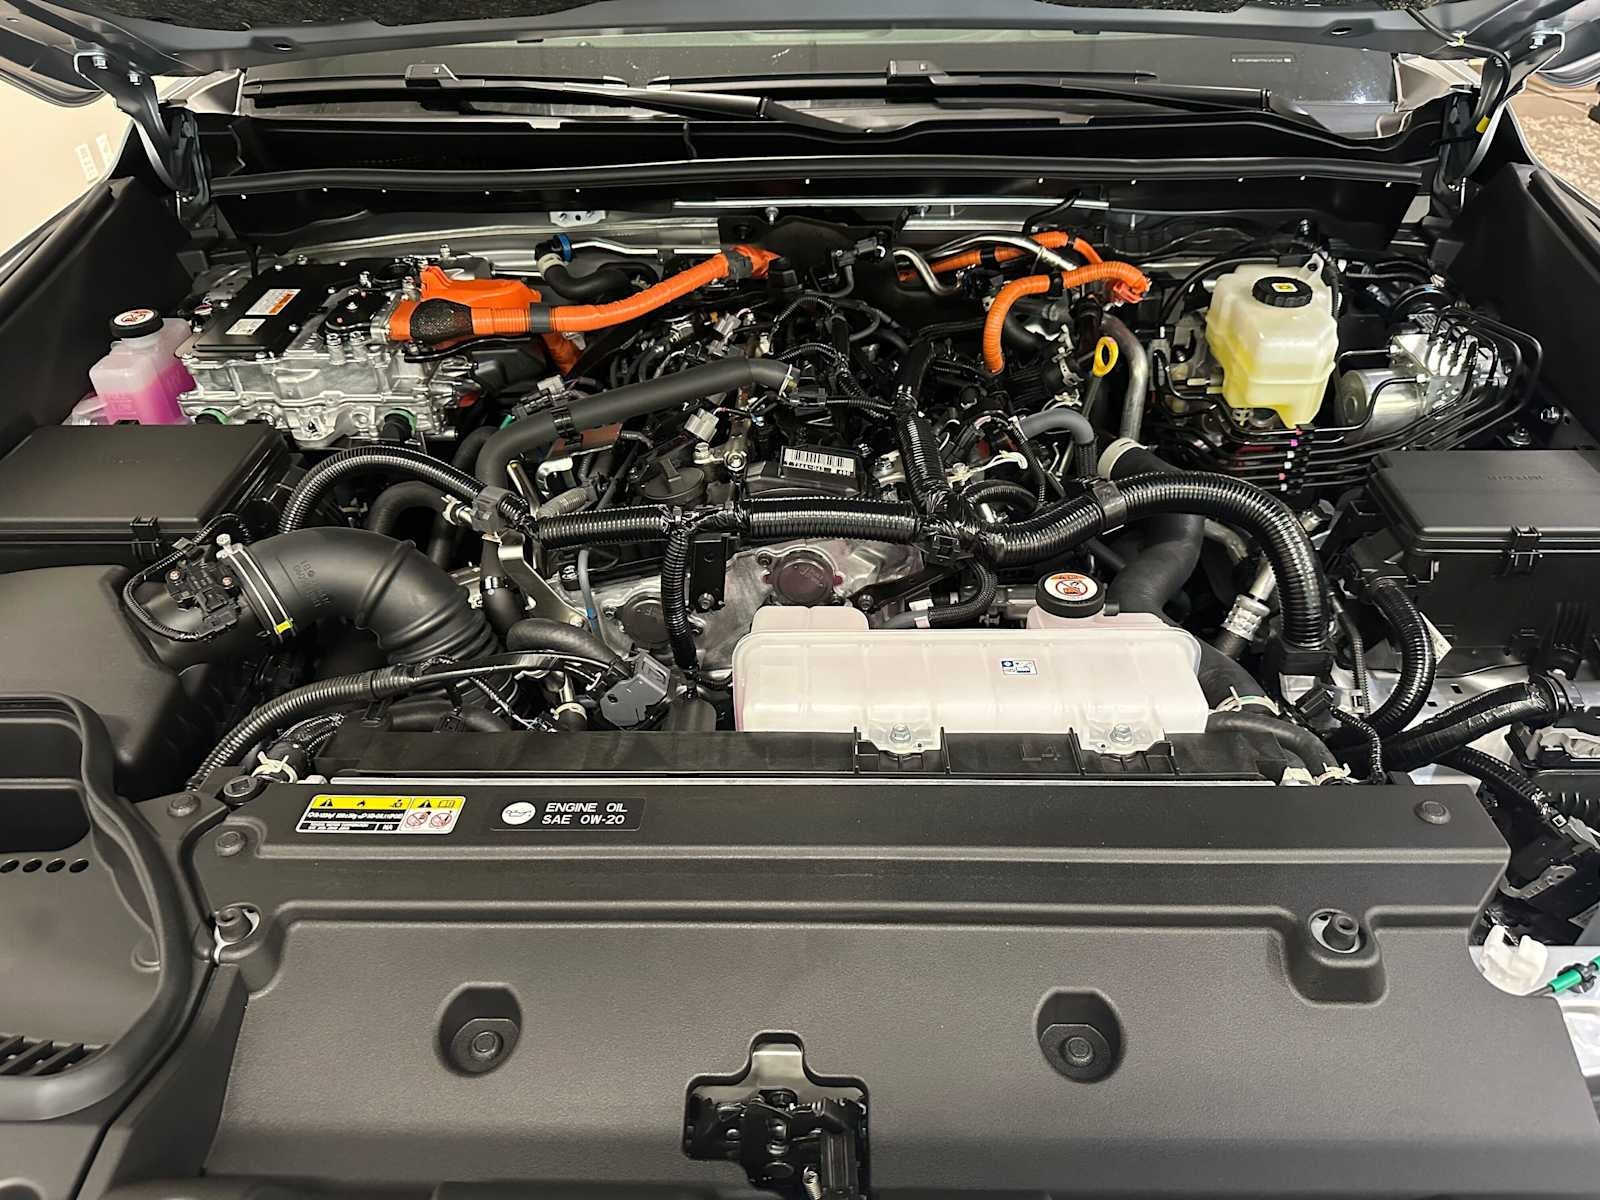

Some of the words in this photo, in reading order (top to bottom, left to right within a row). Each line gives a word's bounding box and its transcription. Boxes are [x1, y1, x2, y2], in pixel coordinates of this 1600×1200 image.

[545, 802, 598, 813] ENGINE
[606, 802, 628, 813] OIL
[541, 814, 572, 825] SAE
[580, 814, 625, 825] 0W-20
